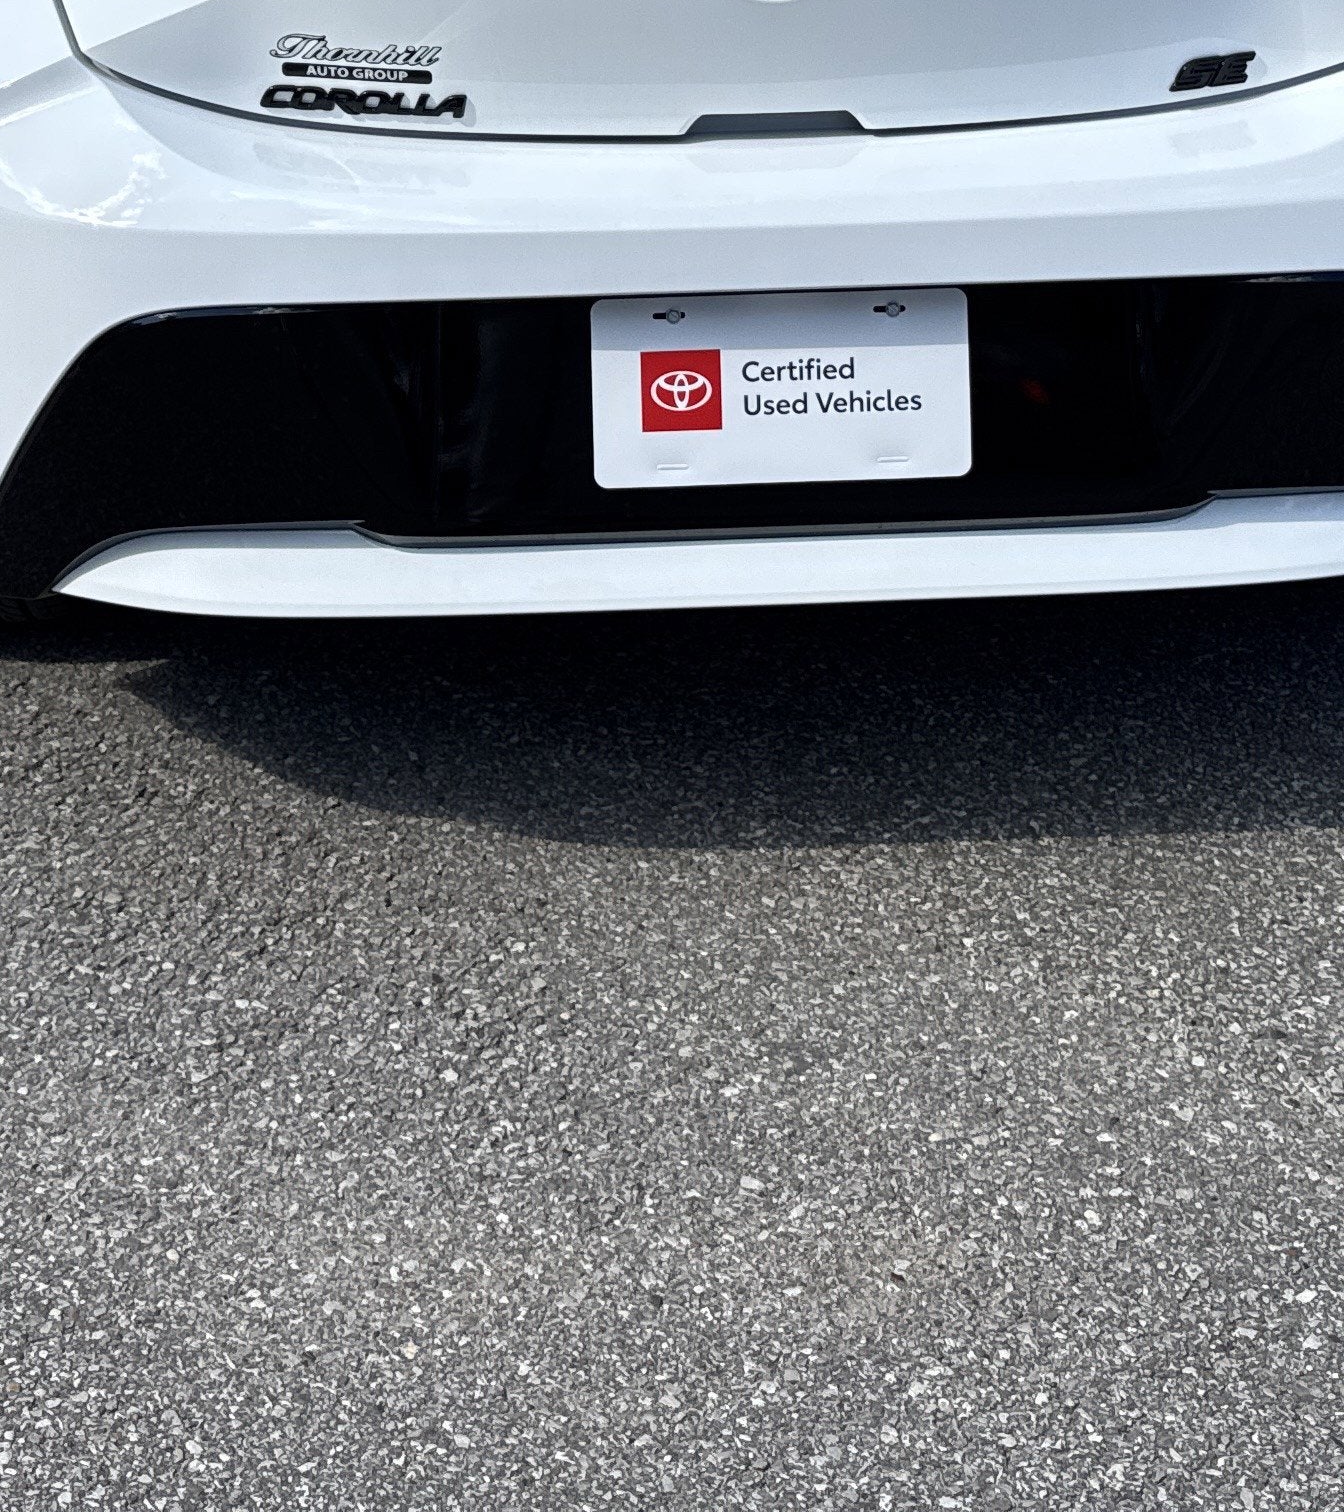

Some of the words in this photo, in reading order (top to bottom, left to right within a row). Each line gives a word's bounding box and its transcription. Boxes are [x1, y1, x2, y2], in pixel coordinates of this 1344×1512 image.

[269, 33, 442, 67] Thornhill
[306, 65, 350, 78] AUTO
[353, 68, 408, 81] GROUP
[1169, 50, 1256, 92] SE
[260, 84, 467, 118] COROLLA
[741, 357, 855, 382] Certified
[743, 392, 808, 416] Used
[815, 389, 922, 414] Vehicles
